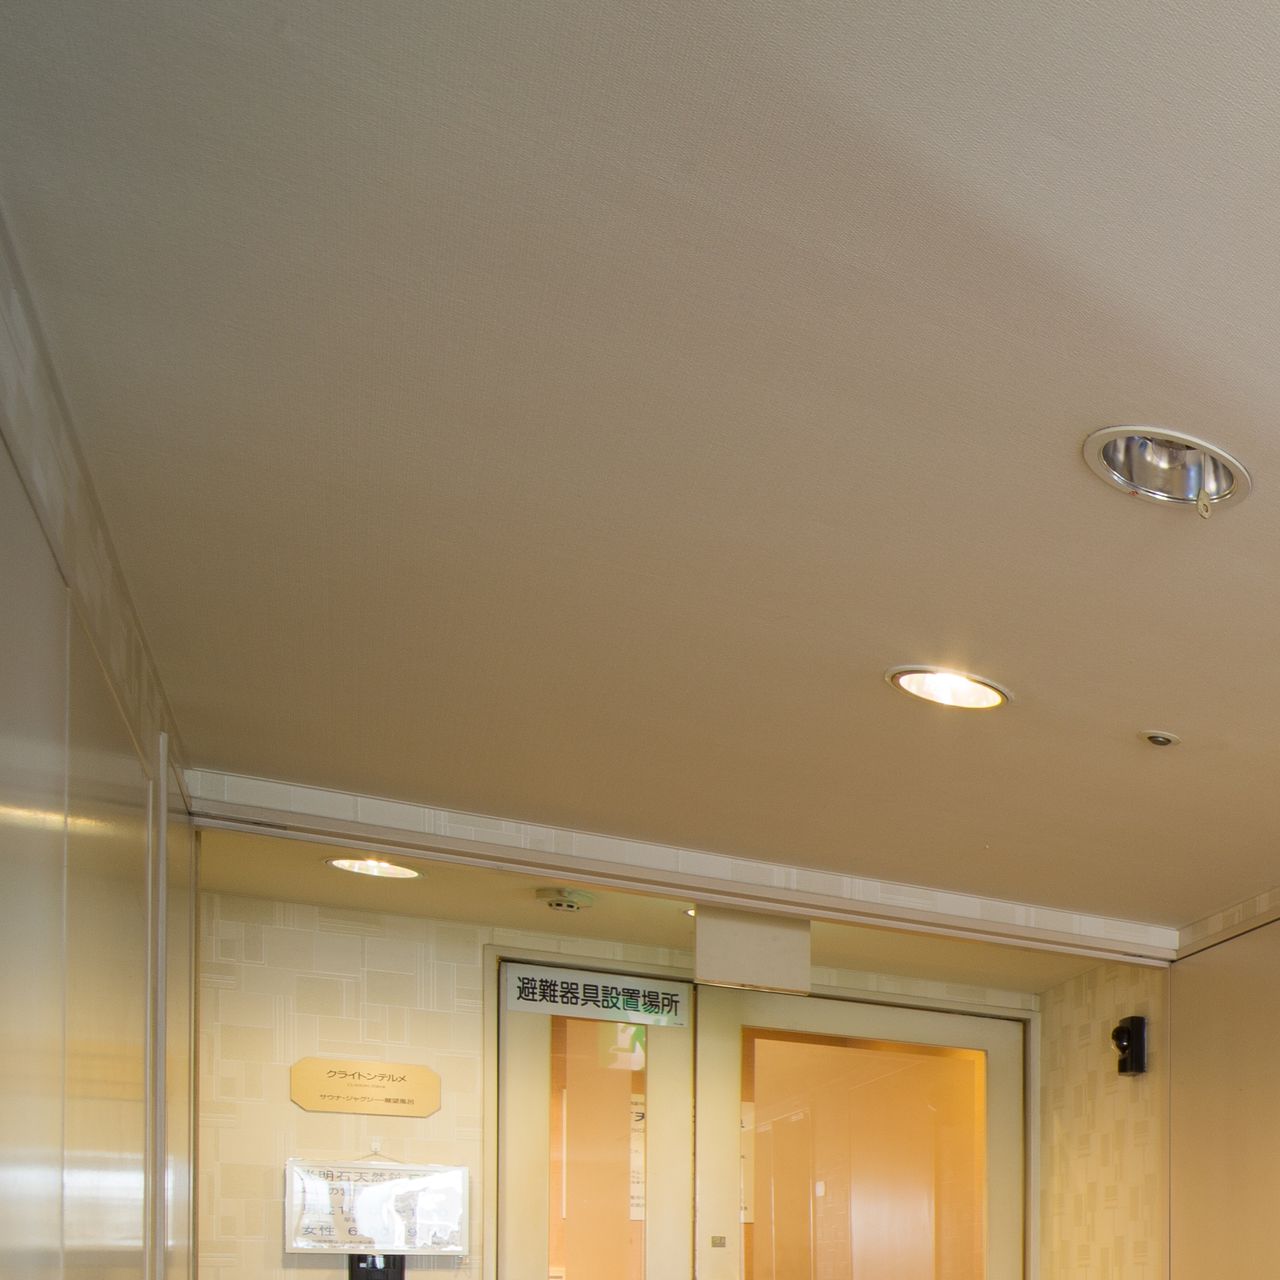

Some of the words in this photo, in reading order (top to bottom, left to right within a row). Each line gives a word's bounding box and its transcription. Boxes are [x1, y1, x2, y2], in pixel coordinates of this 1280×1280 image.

[516, 976, 680, 1017] 避難器具設置場所
[326, 1070, 407, 1083] クライトンテルメ
